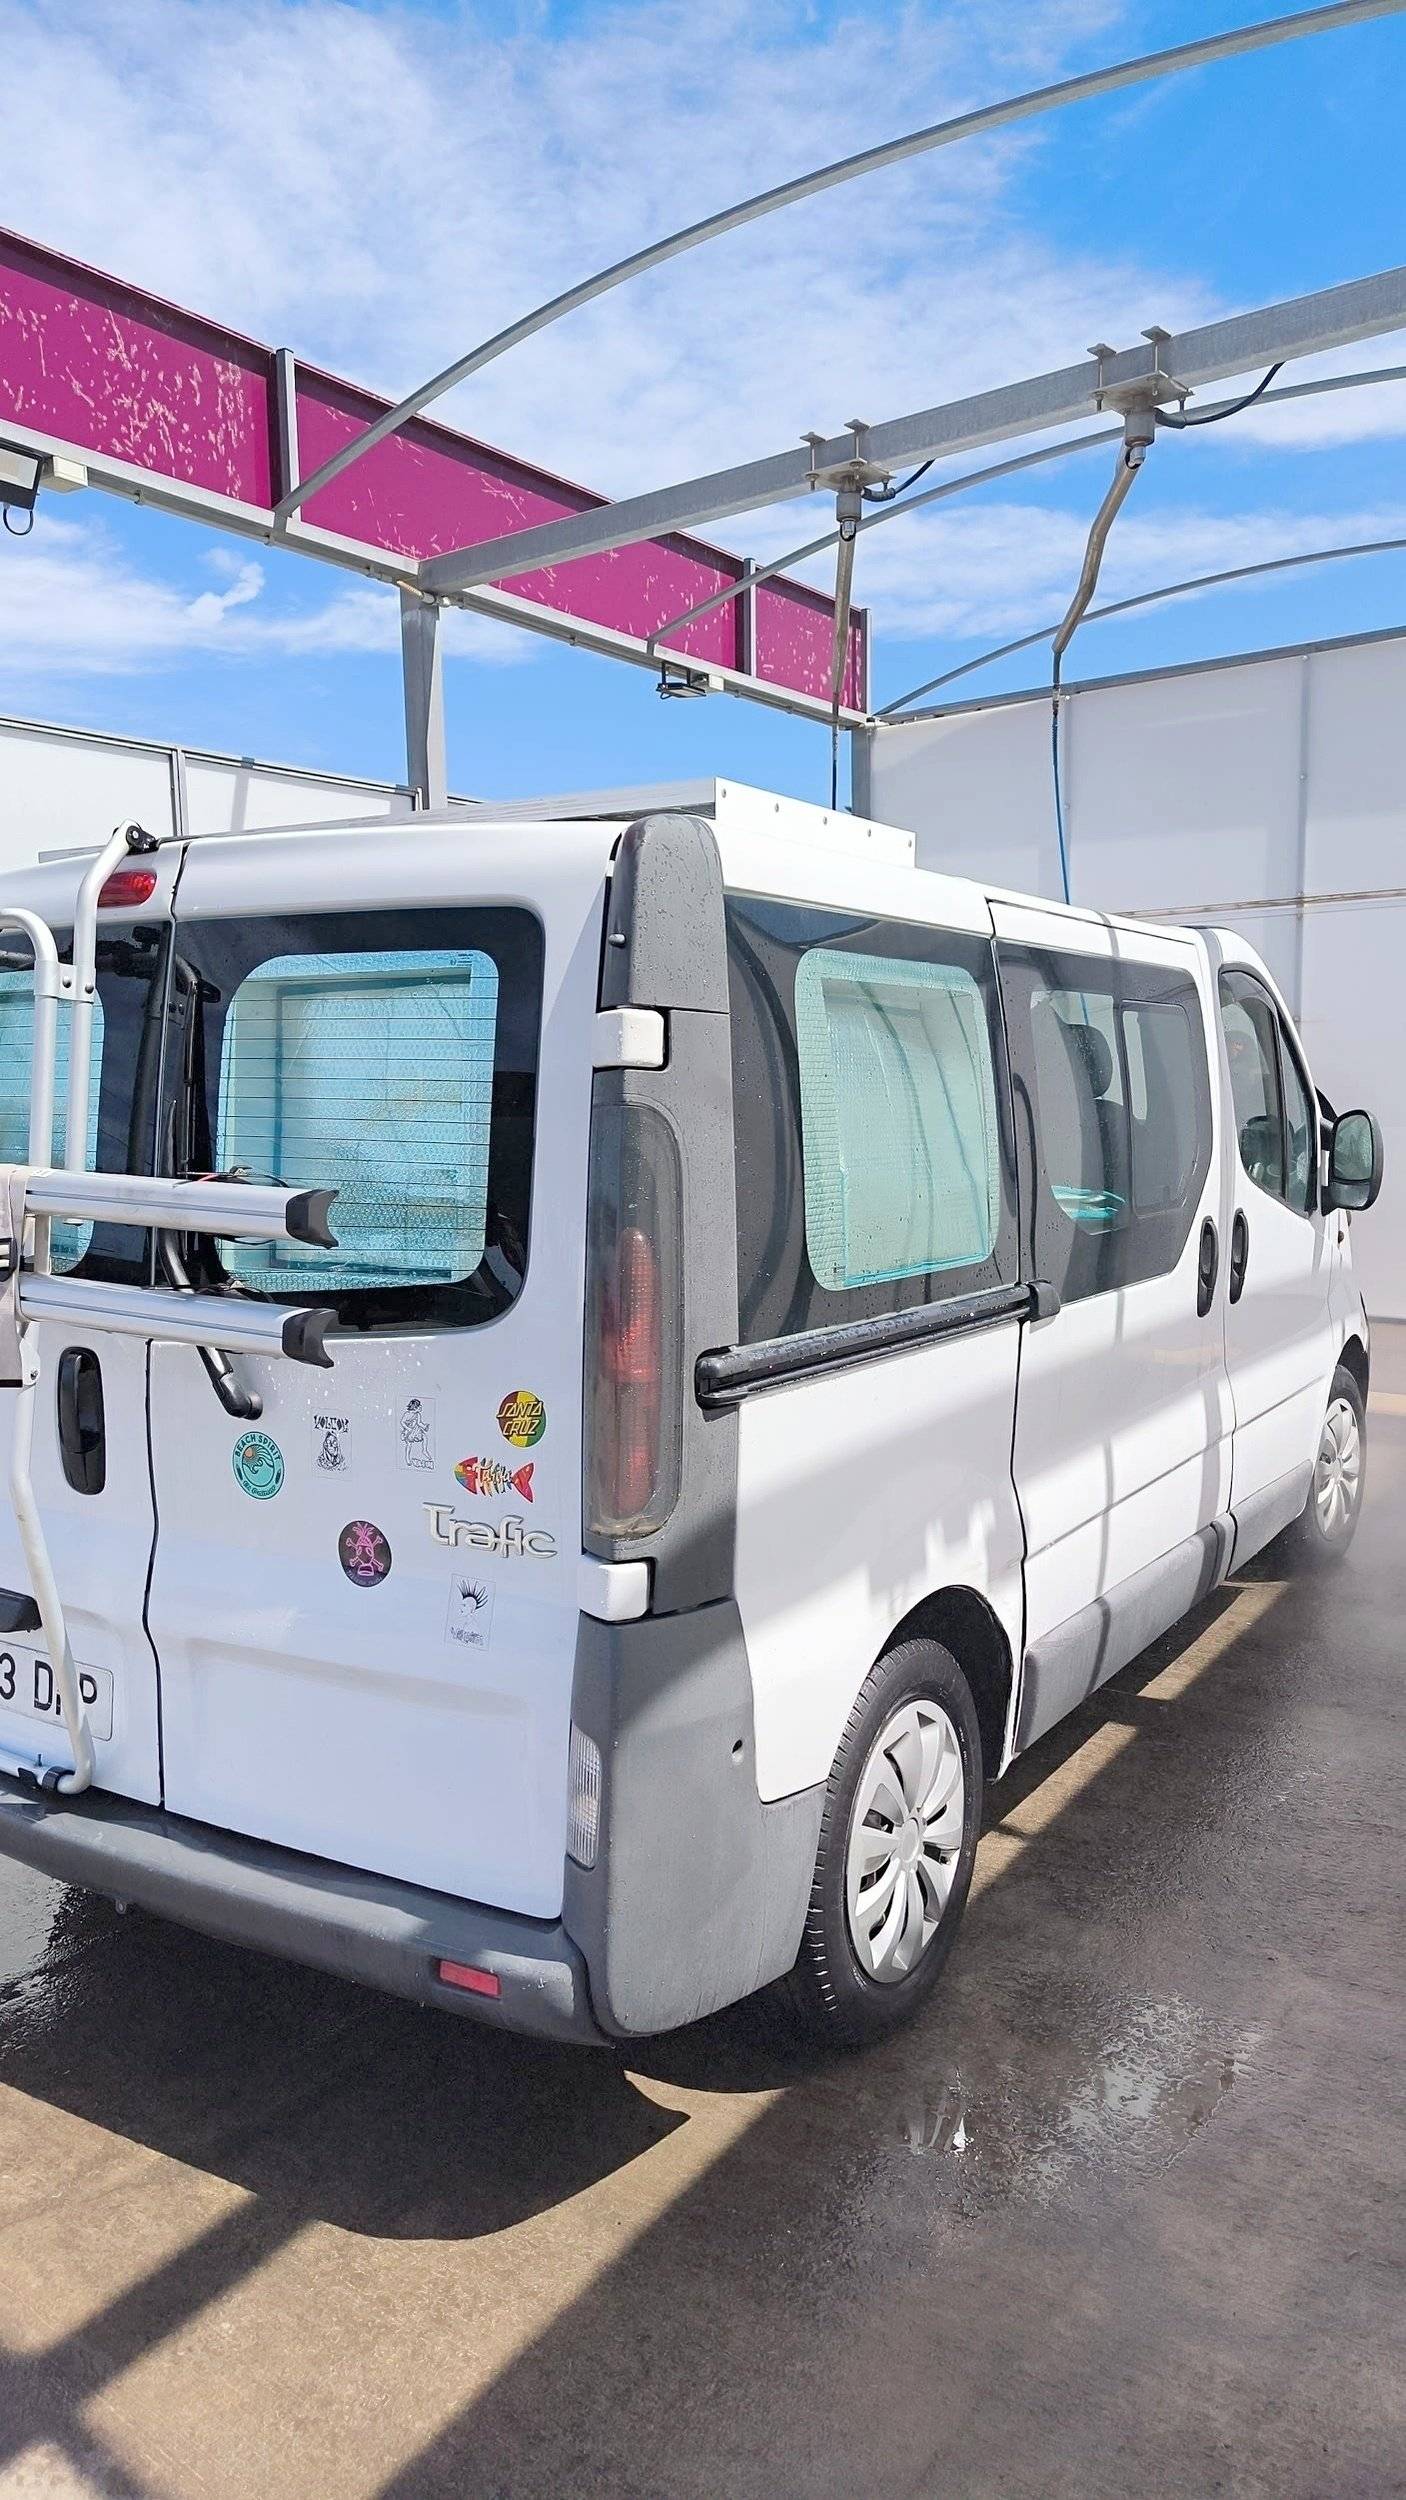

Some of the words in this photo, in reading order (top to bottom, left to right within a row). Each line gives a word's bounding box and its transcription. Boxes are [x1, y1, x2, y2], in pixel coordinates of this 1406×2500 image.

[497, 1400, 543, 1418] SANTA
[502, 1419, 540, 1436] CRUZ
[235, 1433, 256, 1457] BEACH
[258, 1435, 281, 1460] SPIRIT
[422, 1501, 558, 1559] Trafic
[0, 1652, 16, 1700] 3
[34, 1660, 98, 1716] DP
